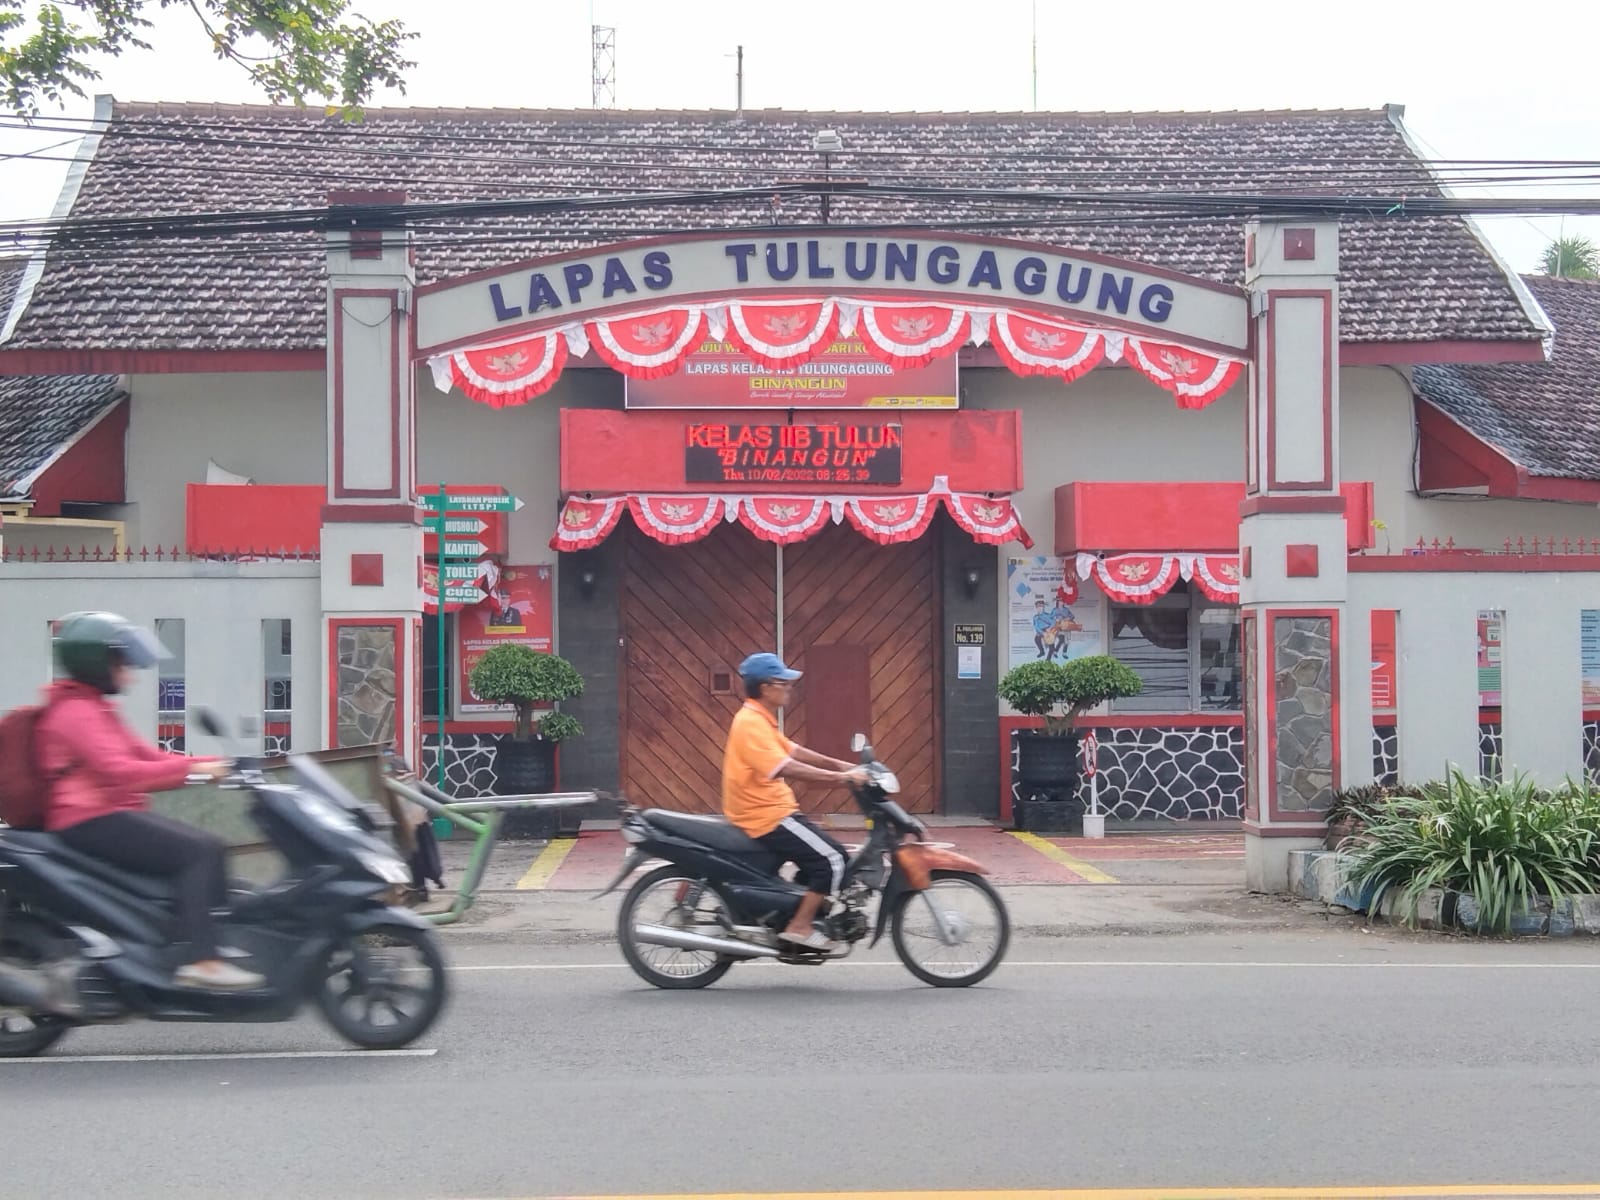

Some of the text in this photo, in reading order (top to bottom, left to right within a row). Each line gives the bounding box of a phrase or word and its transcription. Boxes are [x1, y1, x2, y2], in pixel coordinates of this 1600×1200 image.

[489, 238, 1174, 323] LAPAS TULUNGAGUNG
[687, 363, 728, 374] LAPAS
[798, 364, 893, 375] TULUNGAGUNG
[751, 378, 846, 389] BINANGUN
[688, 424, 772, 448] KELAS
[780, 425, 811, 448] IIB
[723, 468, 745, 480] Thu
[483, 496, 510, 504] PUBLIK
[445, 521, 478, 532] MUSHOLA
[445, 543, 478, 555] KANTIN
[445, 566, 478, 578] TOILET
[445, 588, 478, 597] CUCI
[957, 633, 983, 645] No. 139
